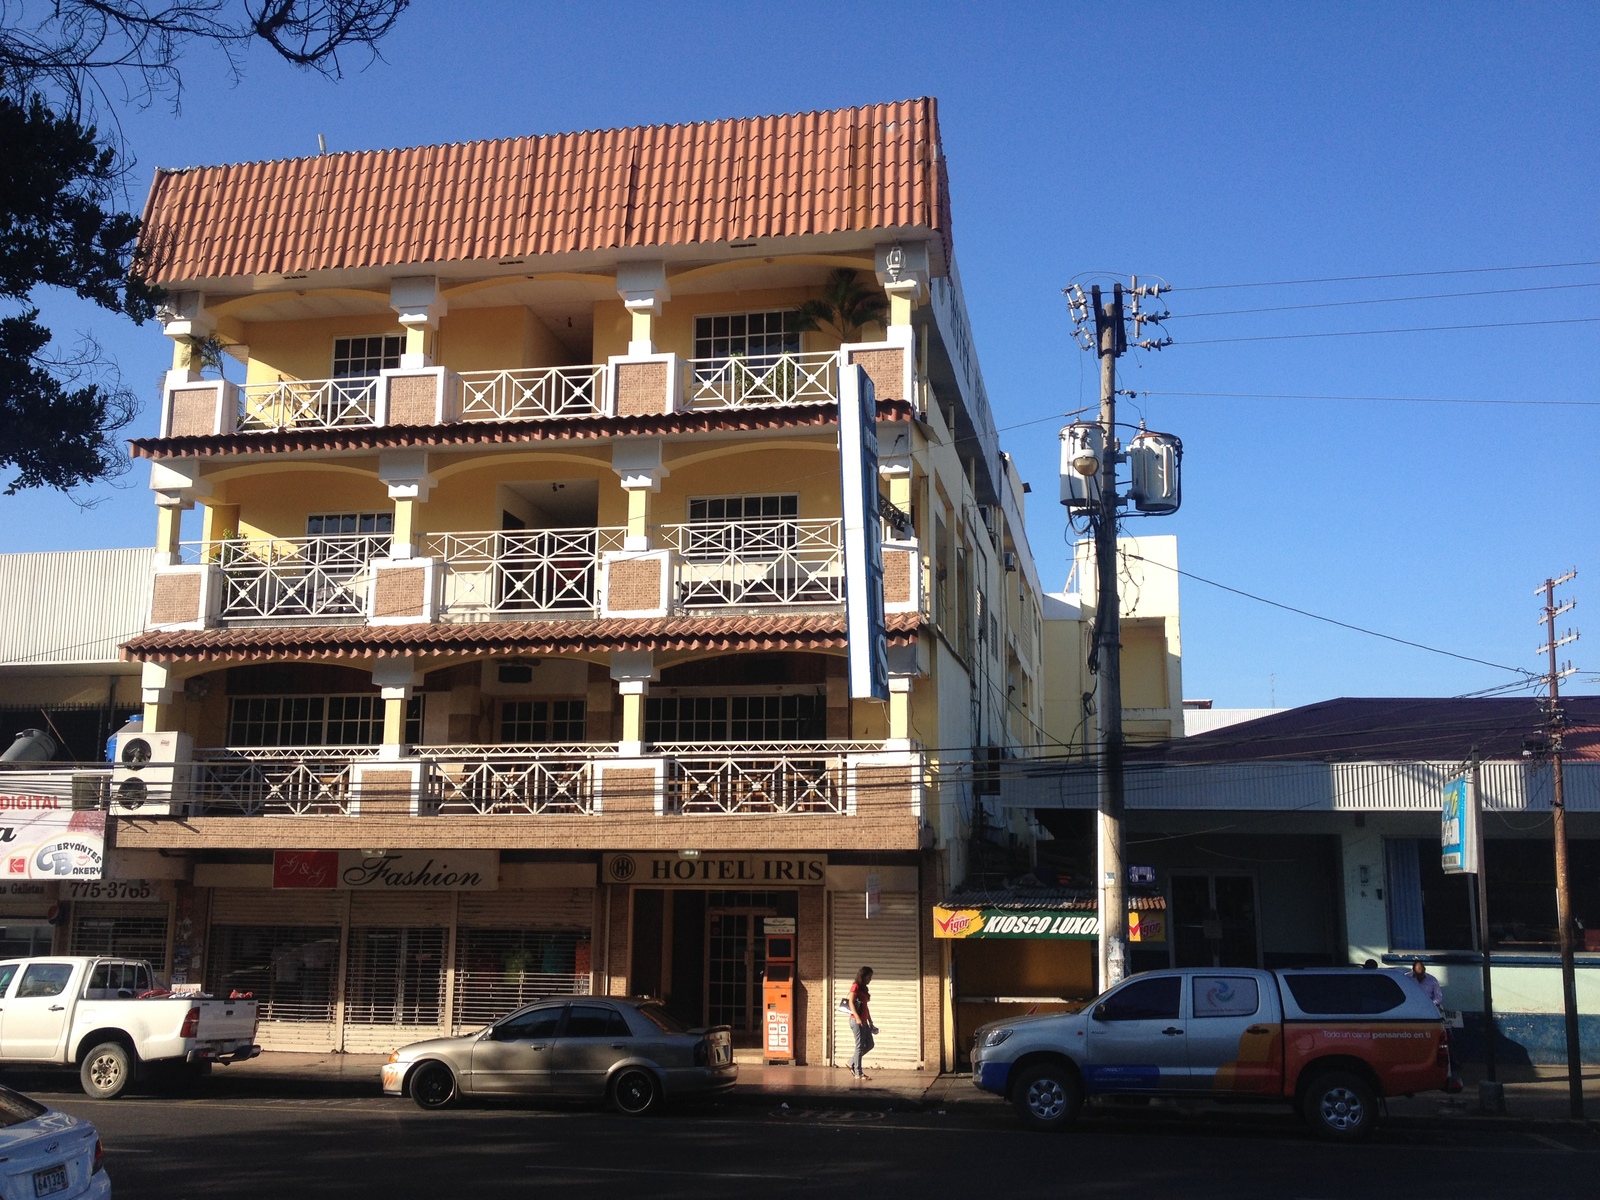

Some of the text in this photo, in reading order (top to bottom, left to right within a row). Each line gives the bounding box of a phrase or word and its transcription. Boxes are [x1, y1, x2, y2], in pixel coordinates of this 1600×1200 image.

[869, 462, 889, 687] IRIS
[0, 795, 61, 810] DIGITAL
[343, 855, 482, 887] Fashion
[651, 859, 823, 880] HOTEL IRIS
[70, 882, 151, 899] 775-3765
[983, 915, 1052, 934] KIOSCO
[1323, 1030, 1341, 1038] Todo
[1372, 1031, 1411, 1039] pensando
